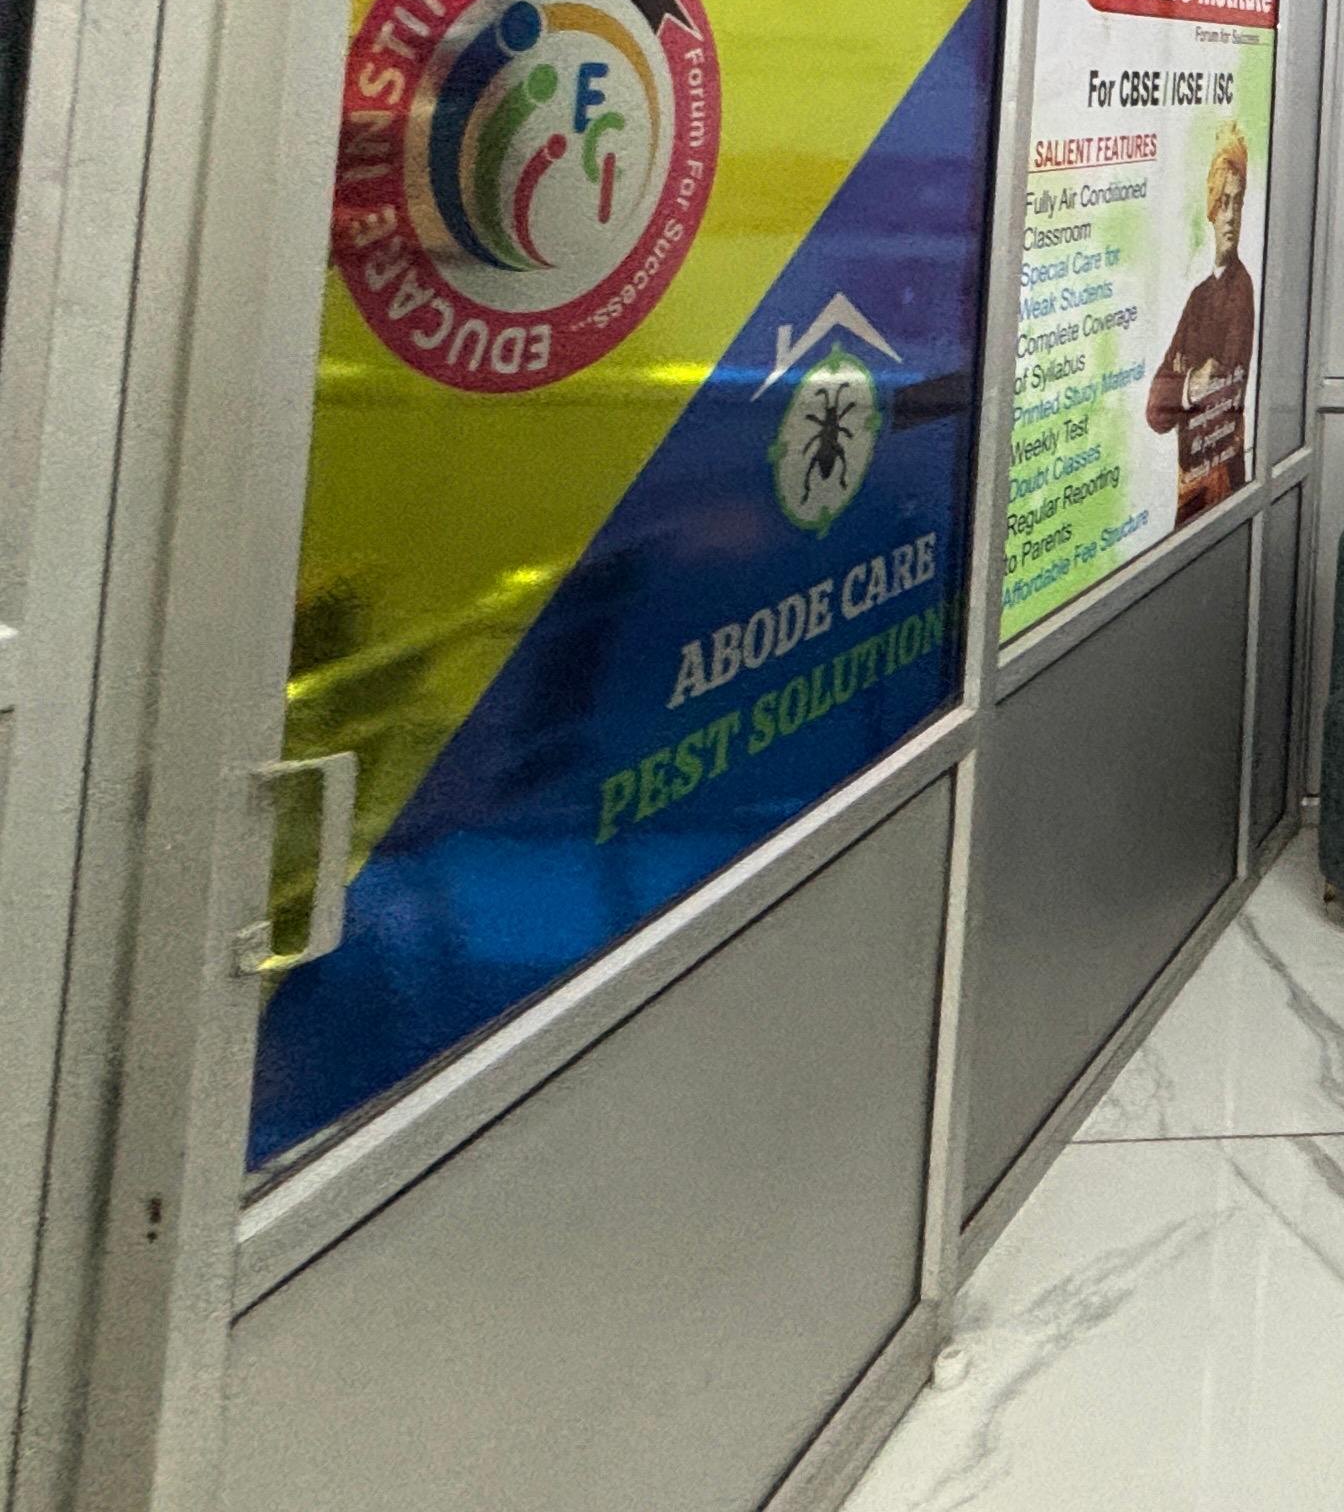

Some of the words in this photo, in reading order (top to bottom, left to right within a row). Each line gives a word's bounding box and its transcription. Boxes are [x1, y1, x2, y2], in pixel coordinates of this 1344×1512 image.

[683, 45, 706, 151] Forum
[1088, 69, 1115, 108] For
[1119, 69, 1160, 108] CBSE
[1171, 71, 1203, 107] ICSE
[1213, 72, 1234, 106] ISC
[1035, 137, 1093, 168] SALIENT
[1097, 133, 1157, 162] FEATURES
[678, 159, 706, 213] For
[1025, 189, 1057, 219] Fully
[1058, 187, 1077, 212] Air
[1080, 177, 1147, 207] Conditioned
[1023, 223, 1092, 251] Classroom
[350, 202, 552, 375] EDUCARE
[1020, 255, 1069, 290] Special
[1072, 251, 1102, 274] Care
[1105, 244, 1120, 268] for
[1018, 292, 1056, 322] Weak
[1060, 280, 1114, 311] Students
[1017, 320, 1079, 359] Complete
[1082, 304, 1138, 338] Coverage
[1013, 391, 1059, 426] Printed
[1063, 382, 1097, 413] Study
[1101, 357, 1146, 395] Material
[1014, 367, 1029, 396] of
[1031, 354, 1085, 393] Syllabus
[1010, 427, 1059, 467] Weekly
[1064, 413, 1089, 444] Test
[1007, 496, 1060, 536] Regular
[1063, 464, 1120, 510] Reporting
[1008, 465, 1049, 504] Doubt
[1053, 443, 1101, 481] Classes
[1002, 557, 1071, 608] Affordable
[1073, 541, 1097, 567] Fee
[1100, 509, 1150, 552] Structure
[1003, 553, 1018, 577] to
[1022, 521, 1072, 567] Parents
[666, 578, 833, 710] ABODE
[841, 531, 936, 620] CARE
[594, 710, 741, 845] PEST
